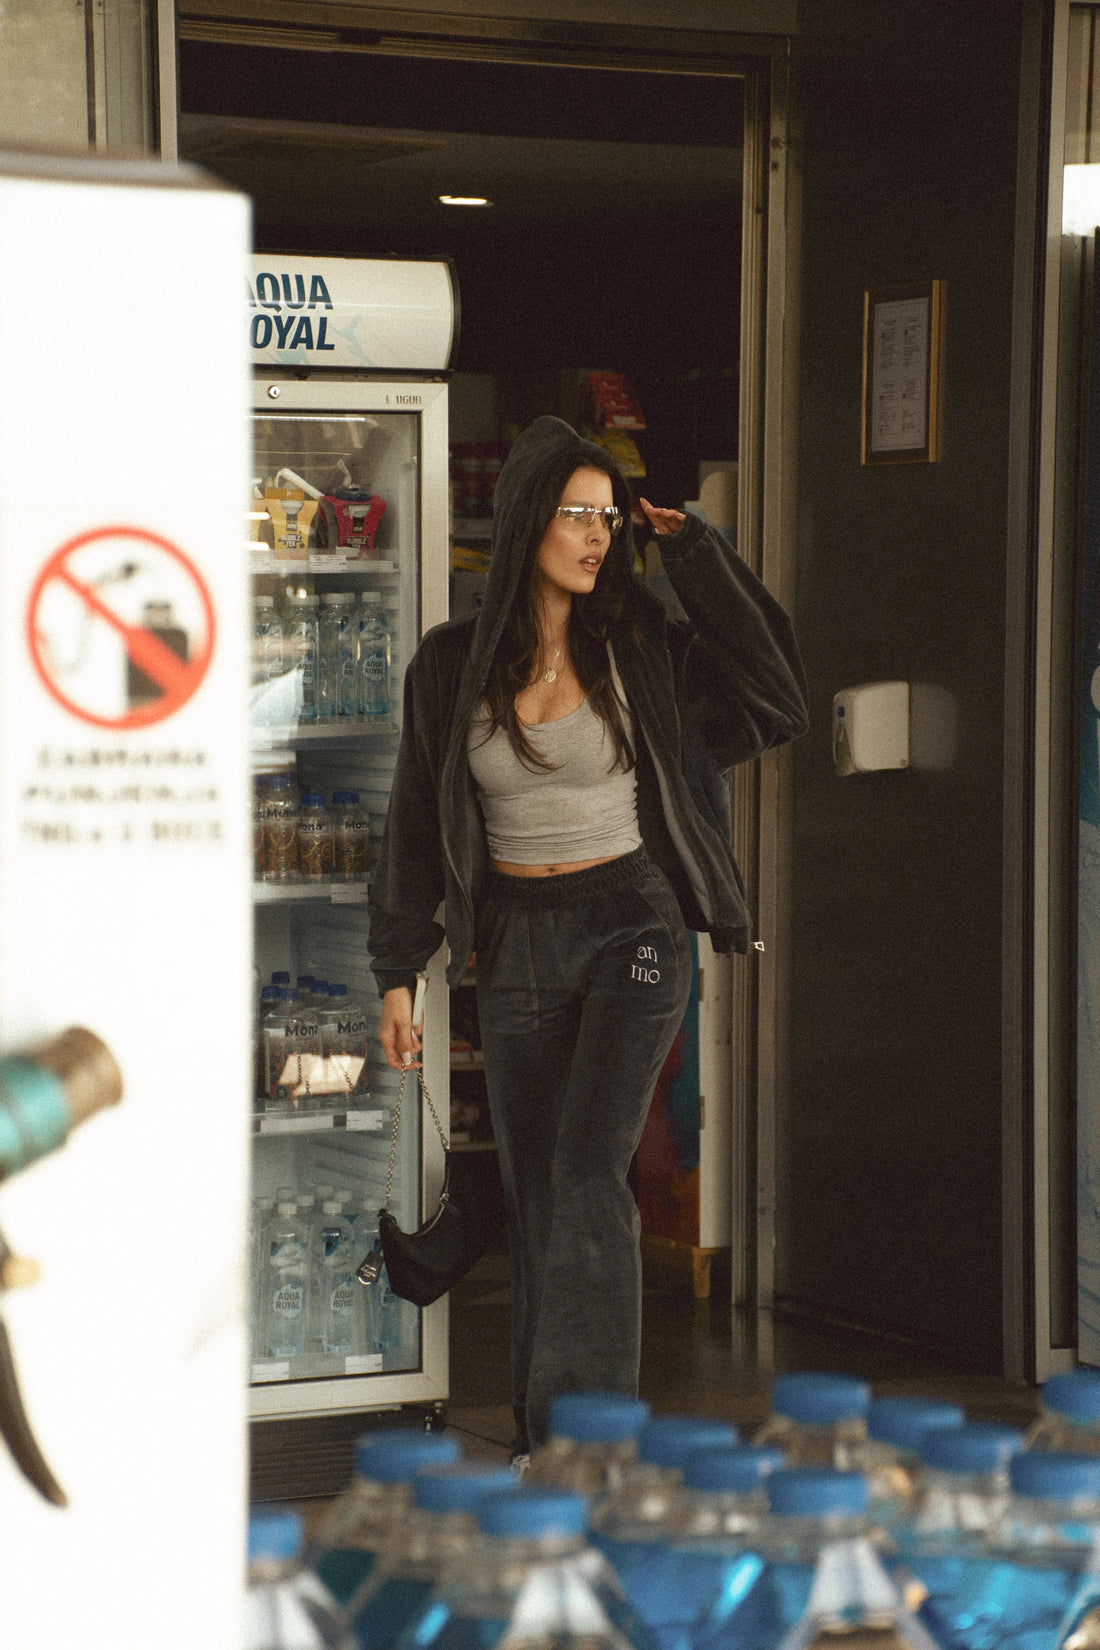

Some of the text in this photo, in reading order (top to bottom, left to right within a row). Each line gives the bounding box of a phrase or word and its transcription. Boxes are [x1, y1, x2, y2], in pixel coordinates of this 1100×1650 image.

[250, 314, 336, 350] OYAL
[637, 946, 658, 963] an
[631, 964, 661, 984] mo
[275, 1301, 300, 1309] ROYAL
[278, 1292, 300, 1301] AQUA
